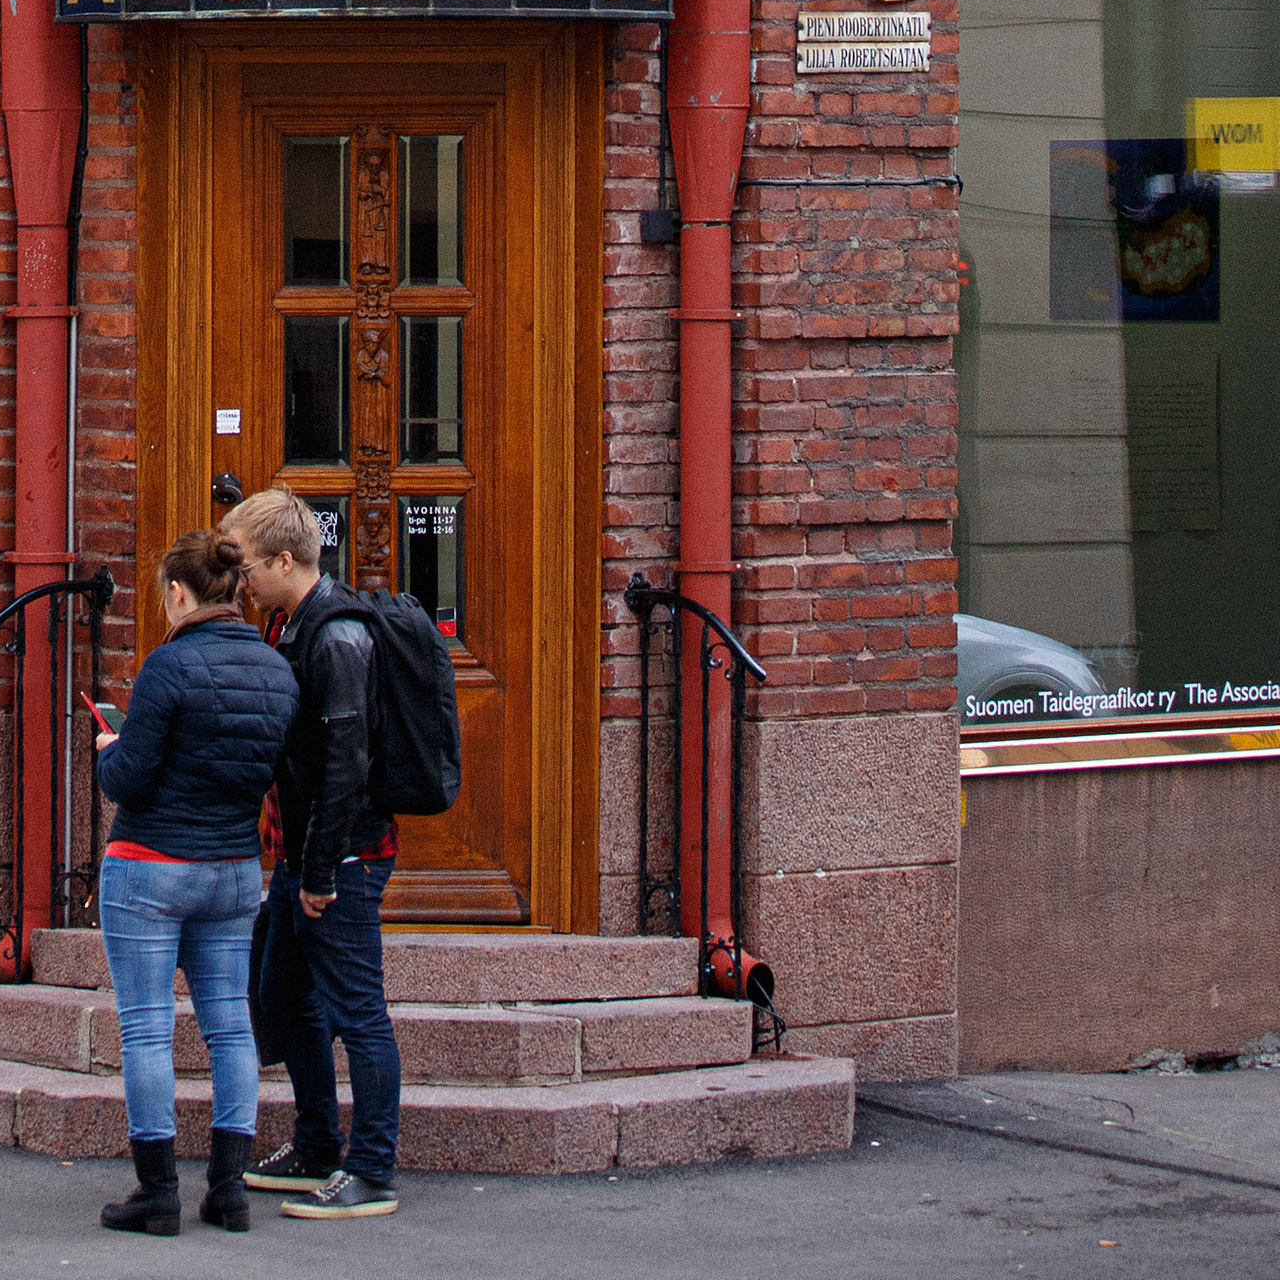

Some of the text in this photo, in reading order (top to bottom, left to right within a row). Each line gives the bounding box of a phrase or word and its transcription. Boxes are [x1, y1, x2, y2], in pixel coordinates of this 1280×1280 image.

[807, 16, 925, 37] PIENI ROOBERTINKATU
[806, 48, 925, 68] LILLA ROBERTSGATAN
[406, 506, 457, 515] AVOINNA
[408, 516, 454, 526] ti-pe 11-17
[408, 526, 454, 535] la-su 12-16
[965, 694, 1034, 718] Suomen
[1038, 687, 1154, 717] Taidegraafikot
[1158, 691, 1176, 712] ry
[1184, 682, 1217, 705] The
